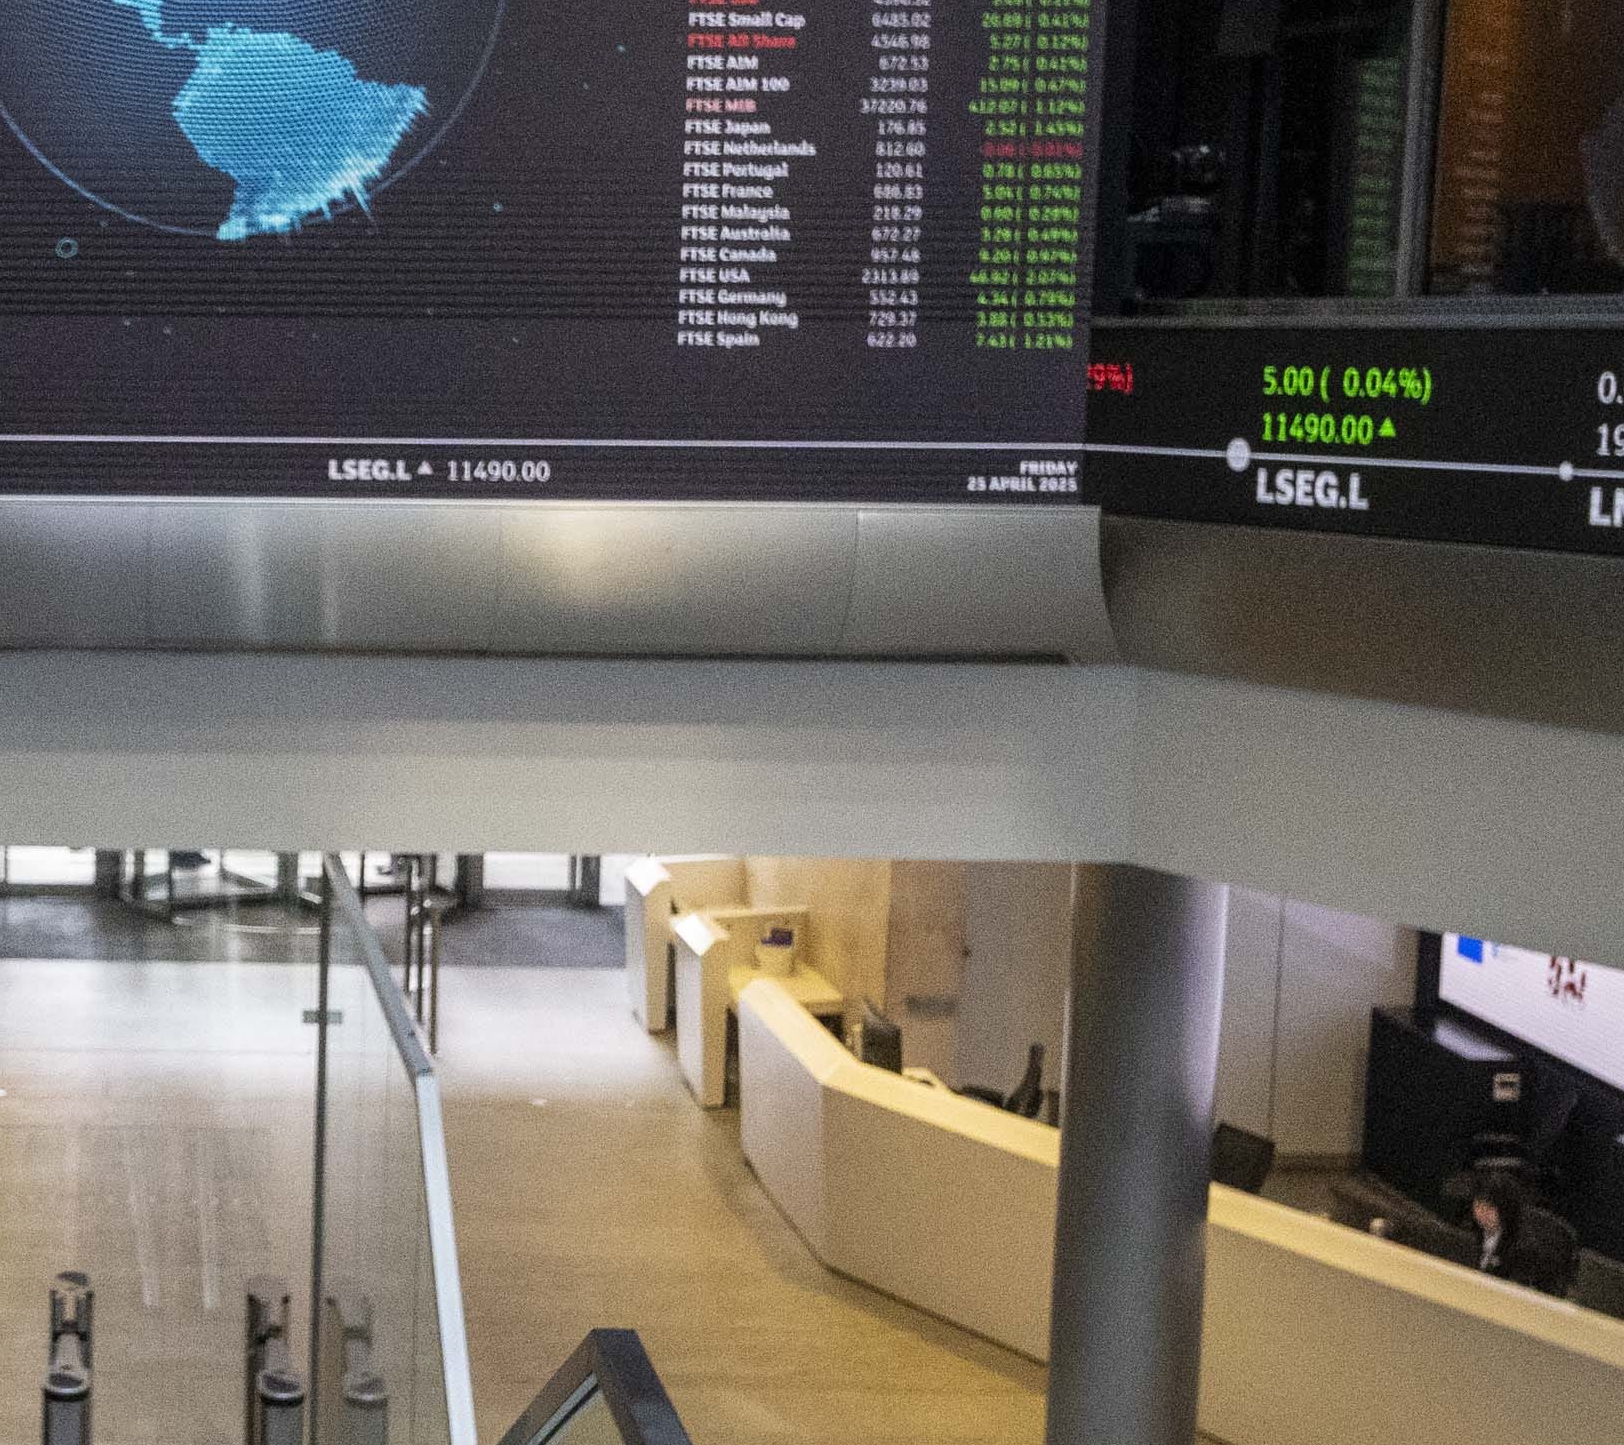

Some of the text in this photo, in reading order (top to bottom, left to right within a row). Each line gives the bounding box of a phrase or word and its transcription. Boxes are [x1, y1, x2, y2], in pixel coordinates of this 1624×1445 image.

[689, 12, 805, 29] FTSE Small Cap
[687, 55, 723, 70] FTSE
[686, 77, 723, 91] FTSE
[725, 77, 757, 91] AIM
[761, 77, 789, 91] 100
[686, 98, 722, 112] FTSE
[685, 119, 770, 137] FTSE Japan
[684, 141, 720, 155] FTSE
[723, 140, 816, 156] Netherlands
[683, 162, 720, 177] FTSE
[723, 162, 788, 180] Portugal
[682, 183, 773, 198] FTSE France
[682, 204, 719, 219] FTSE
[722, 204, 789, 223] Malaysia
[681, 226, 717, 240] FTSE
[721, 225, 790, 240] Australia
[680, 247, 776, 262] FTSE Canada
[680, 268, 716, 283] FTSE
[719, 268, 750, 283] USA
[679, 288, 716, 304] FTSE
[718, 288, 786, 308] Germany
[679, 309, 715, 325] FTSE
[717, 310, 756, 329] Hong
[760, 311, 798, 329] Kong
[678, 331, 714, 346] FTSE
[716, 331, 759, 348] Spain
[1262, 366, 1314, 401] 5.00
[1261, 413, 1374, 445] 11490.00
[328, 459, 550, 482] LSEG.L 11490.00
[1018, 459, 1078, 475] FRIDAY
[967, 475, 1079, 493] 25 APRIL 2025
[1256, 468, 1369, 511] LSEG.L
